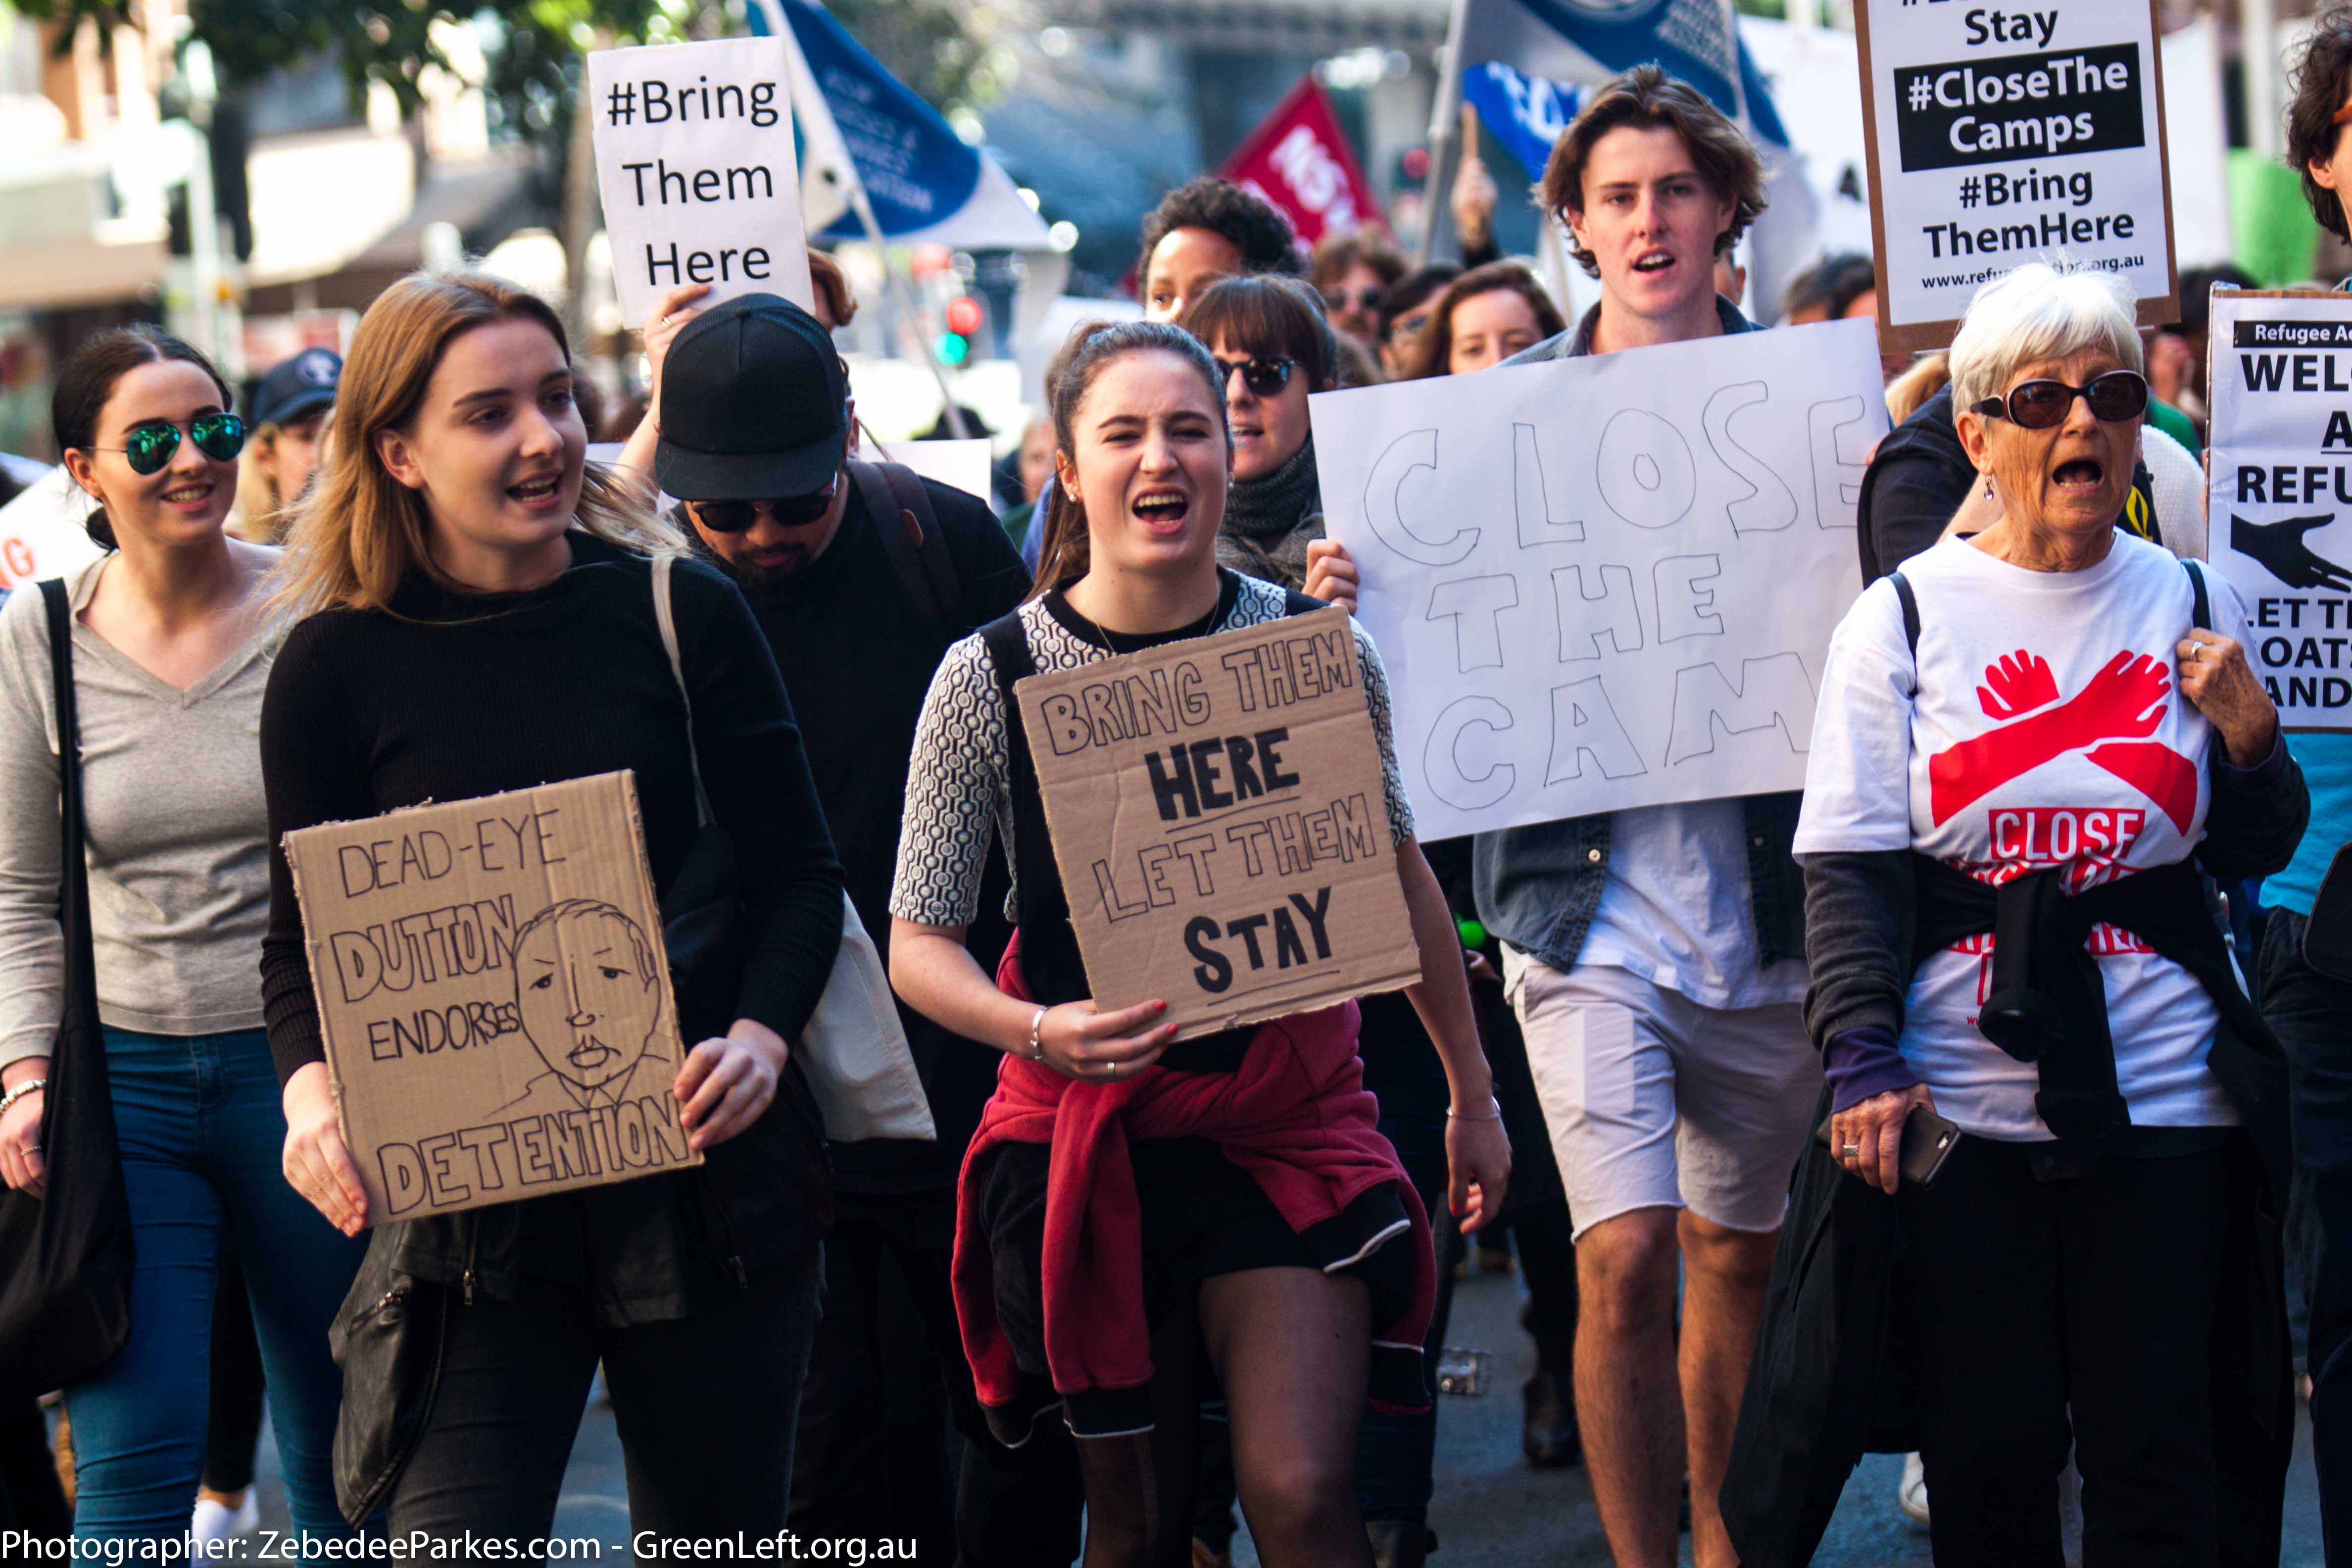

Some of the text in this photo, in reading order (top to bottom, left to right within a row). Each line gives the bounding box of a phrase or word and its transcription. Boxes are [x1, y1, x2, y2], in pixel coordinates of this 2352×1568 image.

[1965, 9, 2058, 49] Stay
[607, 76, 779, 127] #Bring
[1908, 55, 2128, 111] #CloseThe
[1949, 111, 2094, 153] Camps
[622, 159, 773, 206] Them
[1960, 167, 2093, 208] #Bring
[1922, 212, 2135, 258] ThemHere
[646, 243, 771, 287] Here
[2255, 324, 2330, 344] Refugee
[2241, 354, 2352, 392] WEL
[1364, 380, 1867, 566] CLOSE
[1426, 553, 1724, 673] THE
[2247, 598, 2308, 628] ET
[1041, 629, 1353, 756] BRING THEM
[1145, 728, 1300, 821] HERE
[338, 808, 567, 898] DEAD-EYE
[1092, 792, 1376, 924] LET THEM
[330, 893, 517, 1004] DUTTON
[1184, 886, 1332, 993] STAY
[367, 1001, 520, 1061] ENDORSES
[377, 1088, 689, 1215] DETENTION
